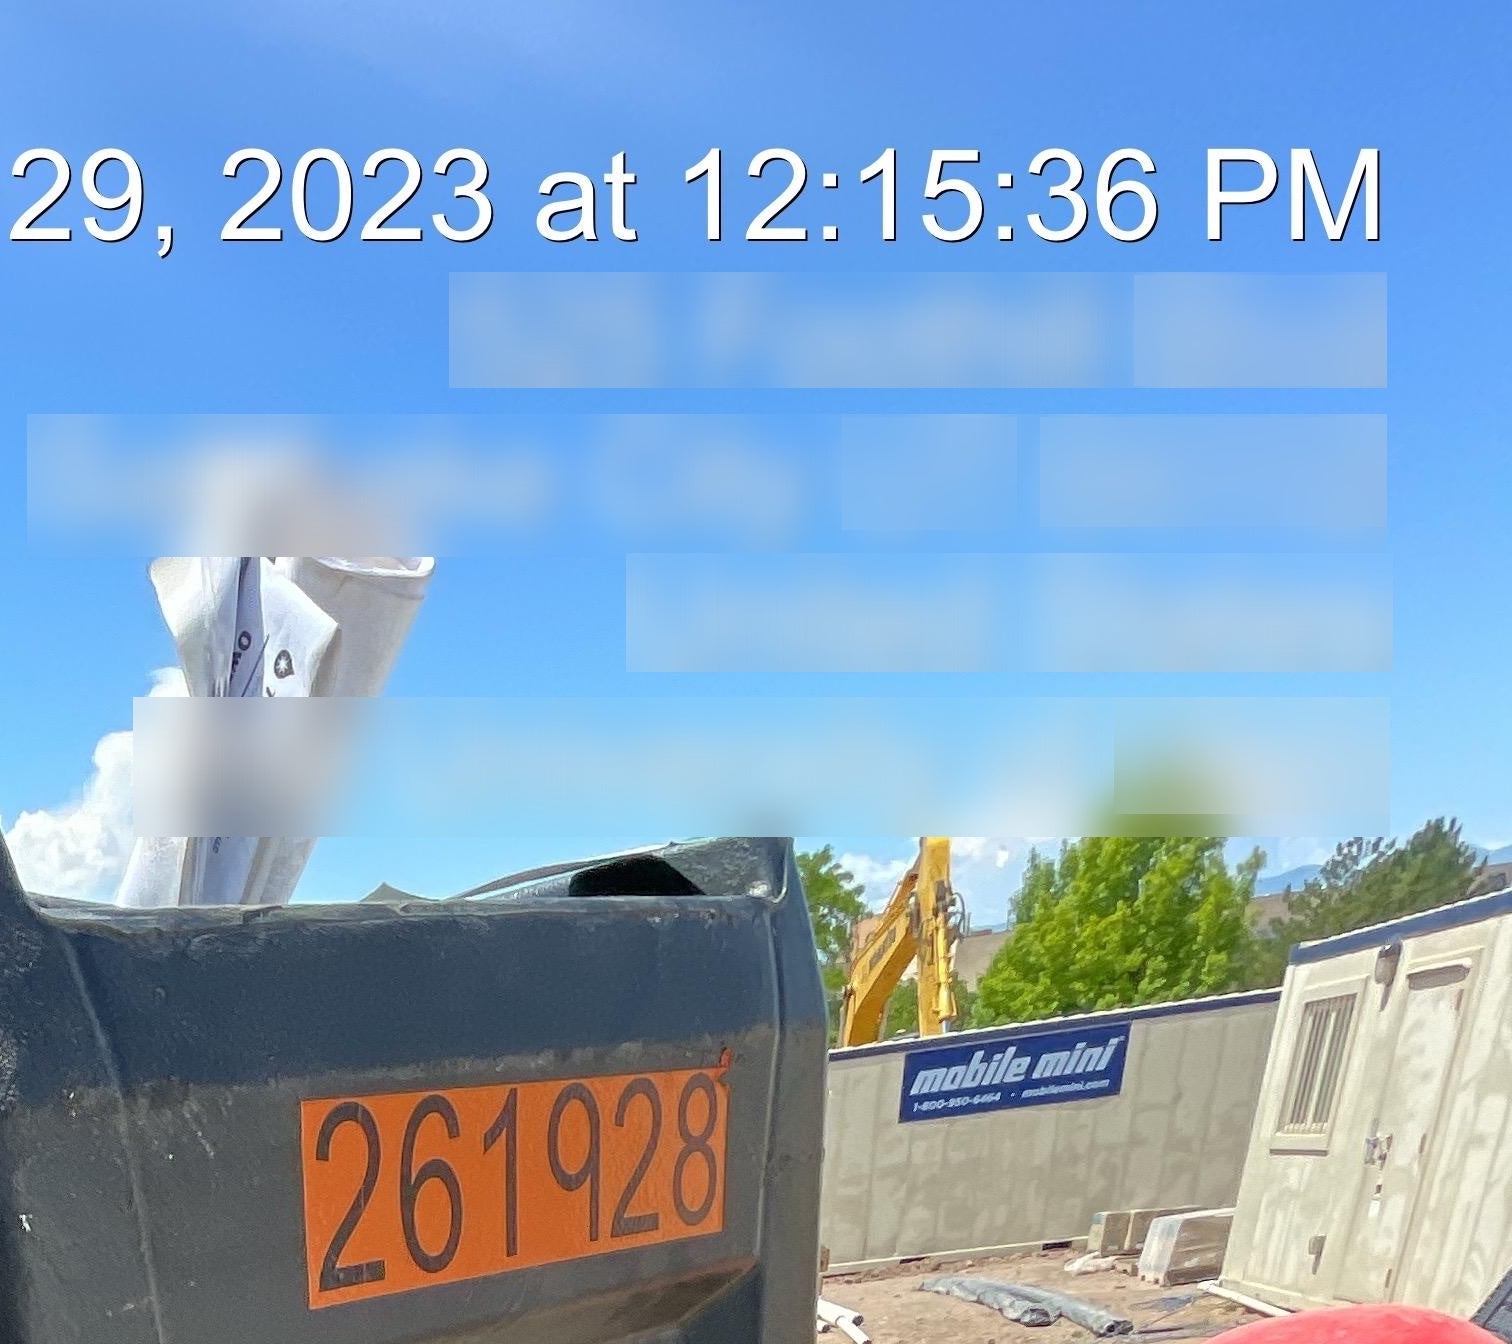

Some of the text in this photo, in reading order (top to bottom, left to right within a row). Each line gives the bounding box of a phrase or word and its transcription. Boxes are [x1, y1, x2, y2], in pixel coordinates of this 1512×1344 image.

[909, 1037, 1121, 1096] mobile mini
[315, 1071, 719, 1293] 261928
